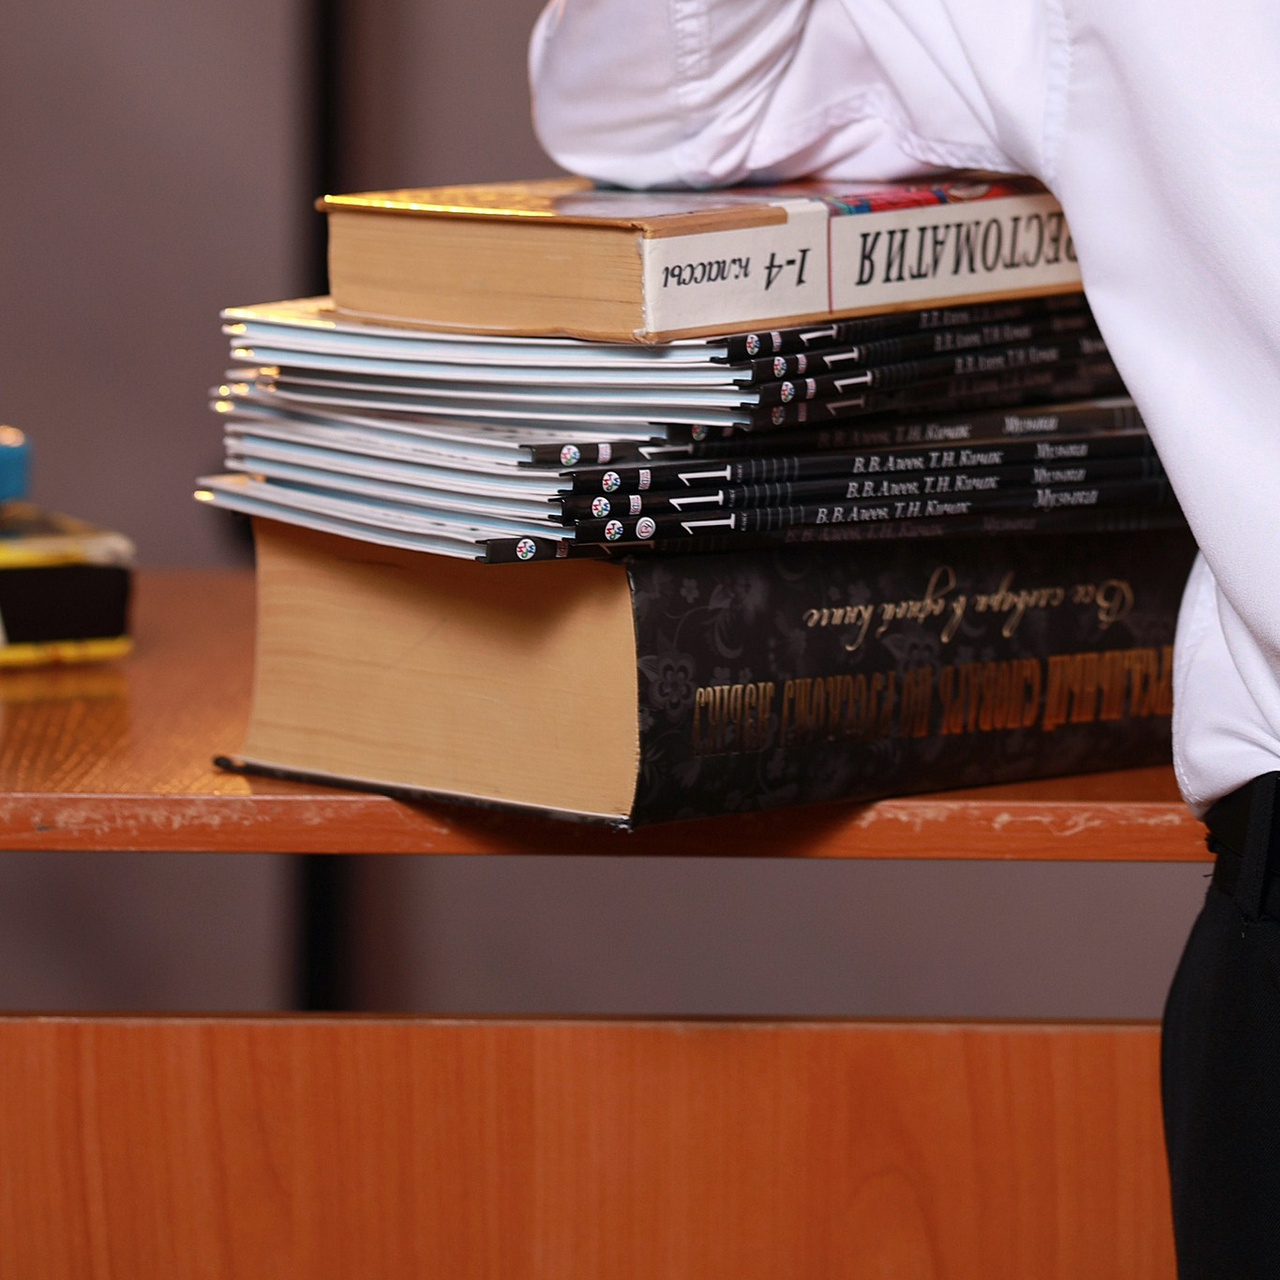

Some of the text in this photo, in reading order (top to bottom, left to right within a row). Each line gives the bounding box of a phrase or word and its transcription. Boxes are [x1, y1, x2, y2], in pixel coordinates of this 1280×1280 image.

[662, 248, 811, 291] 1-4 классы
[678, 464, 732, 487] 1
[669, 490, 724, 511] 1
[680, 513, 736, 535] 1
[876, 564, 958, 638] одной
[976, 571, 1066, 638] словари
[1071, 579, 1135, 630] Все
[803, 606, 871, 651] книге
